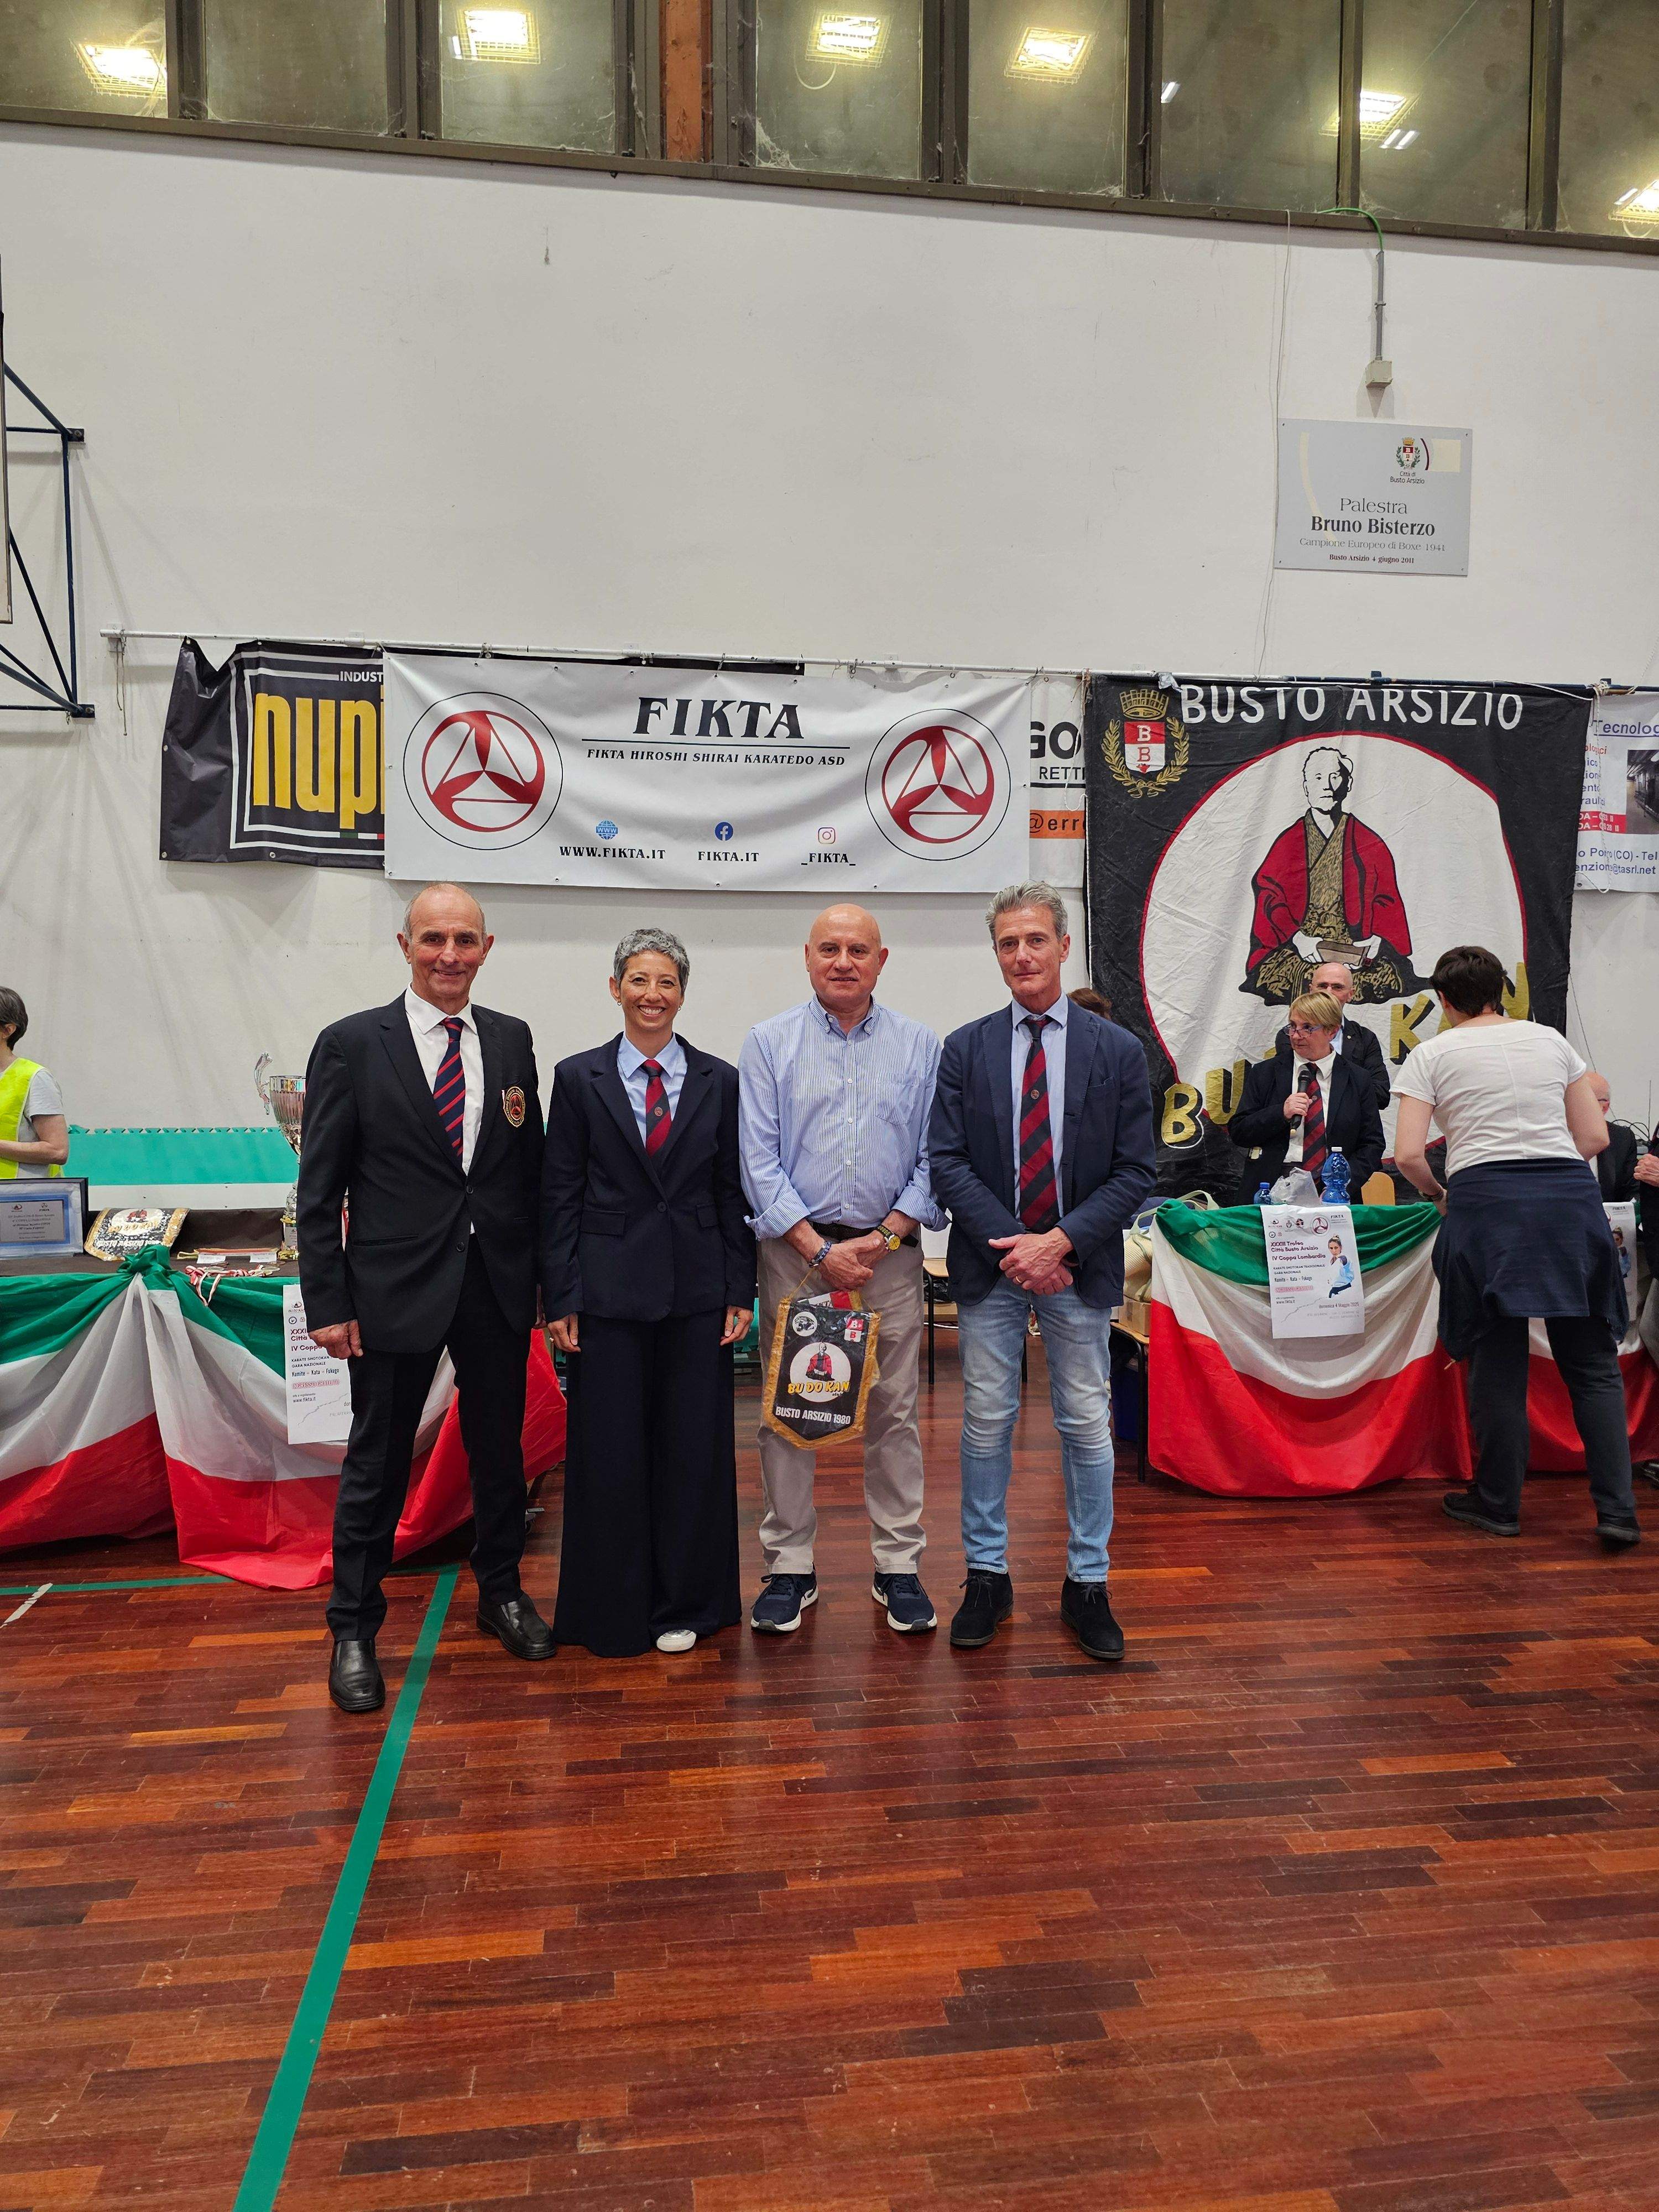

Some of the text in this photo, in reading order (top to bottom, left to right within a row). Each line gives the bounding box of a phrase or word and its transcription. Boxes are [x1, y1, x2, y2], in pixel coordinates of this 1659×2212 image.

[1340, 498, 1407, 514] Palestra
[1311, 515, 1435, 536] Bruno Bisterzo
[1300, 538, 1345, 549] Campione
[1348, 540, 1385, 550] Europeo
[1399, 542, 1422, 551] Boxe
[1378, 555, 1400, 564] giugno
[340, 671, 384, 682] INDUST
[1180, 684, 1523, 730] BUSTO ARSIZIO
[632, 696, 805, 739] FIKTA
[1137, 724, 1151, 742] B
[587, 749, 846, 766] FIKTA HIROSHI SHIRAI KARATEDO ASD
[1137, 747, 1151, 762] B
[559, 846, 666, 859] WWW.FIKTA.IT
[697, 851, 759, 863] FIKTA.IT
[787, 1381, 850, 1395] BU DO KAN
[775, 1406, 851, 1425] BUSTO ARSIZIO 1980
